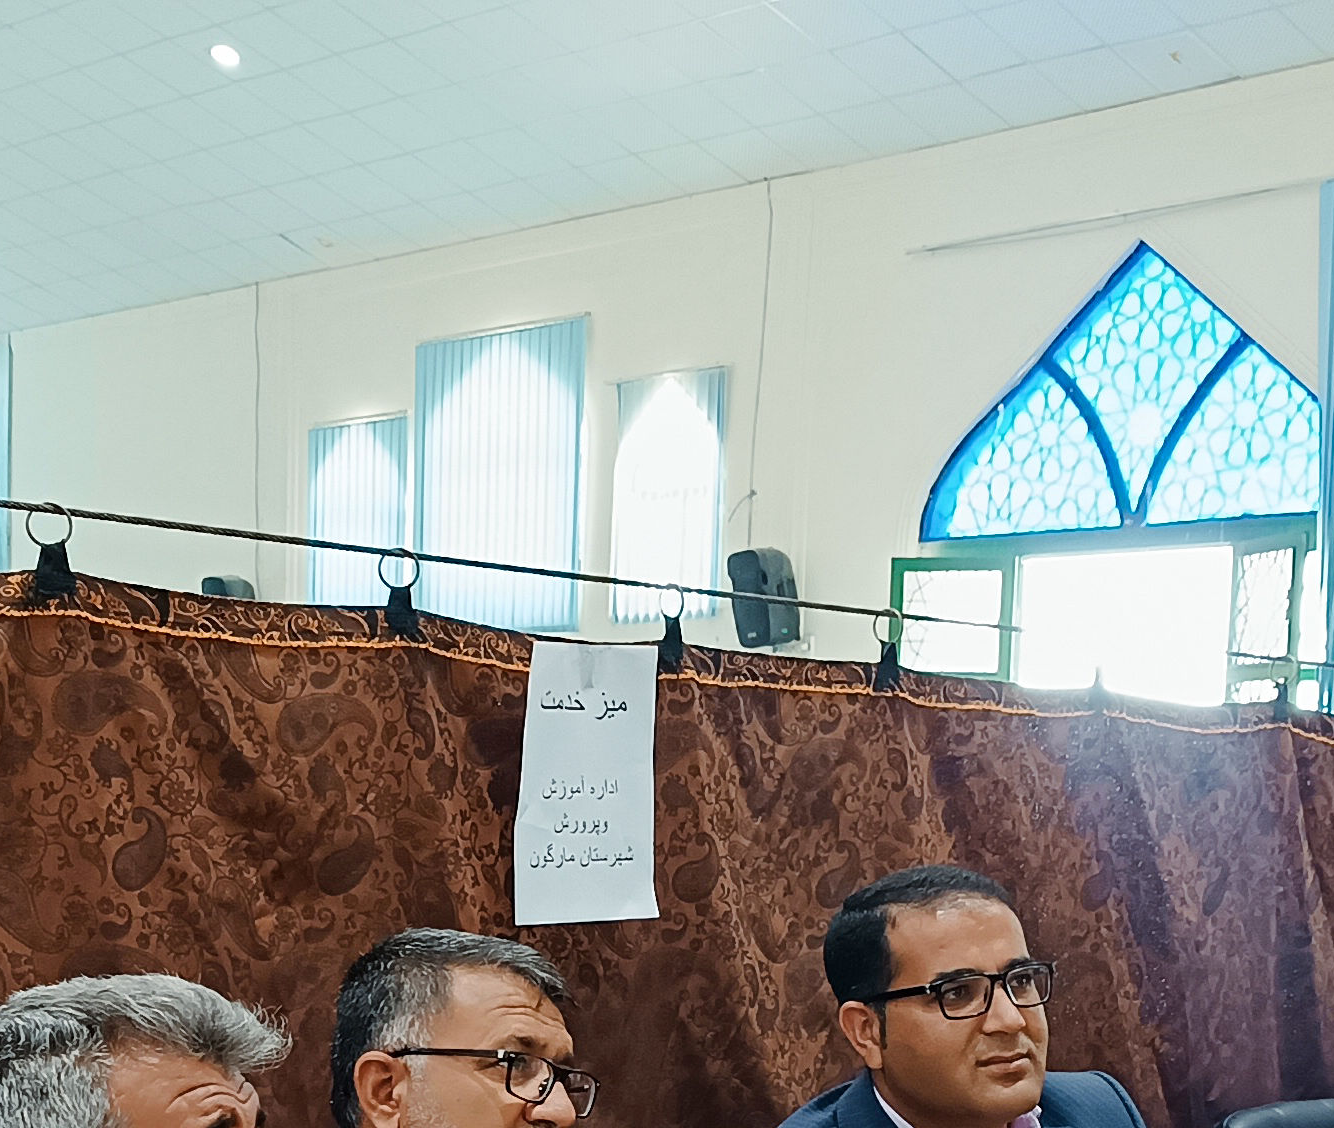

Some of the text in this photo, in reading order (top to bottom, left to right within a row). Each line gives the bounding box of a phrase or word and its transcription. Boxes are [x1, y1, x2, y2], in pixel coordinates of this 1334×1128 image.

[540, 690, 628, 720] میز خدمت
[541, 775, 619, 800] اداره آموزش
[553, 812, 609, 836] وپرورش
[529, 843, 635, 870] شهرستان مارگون
